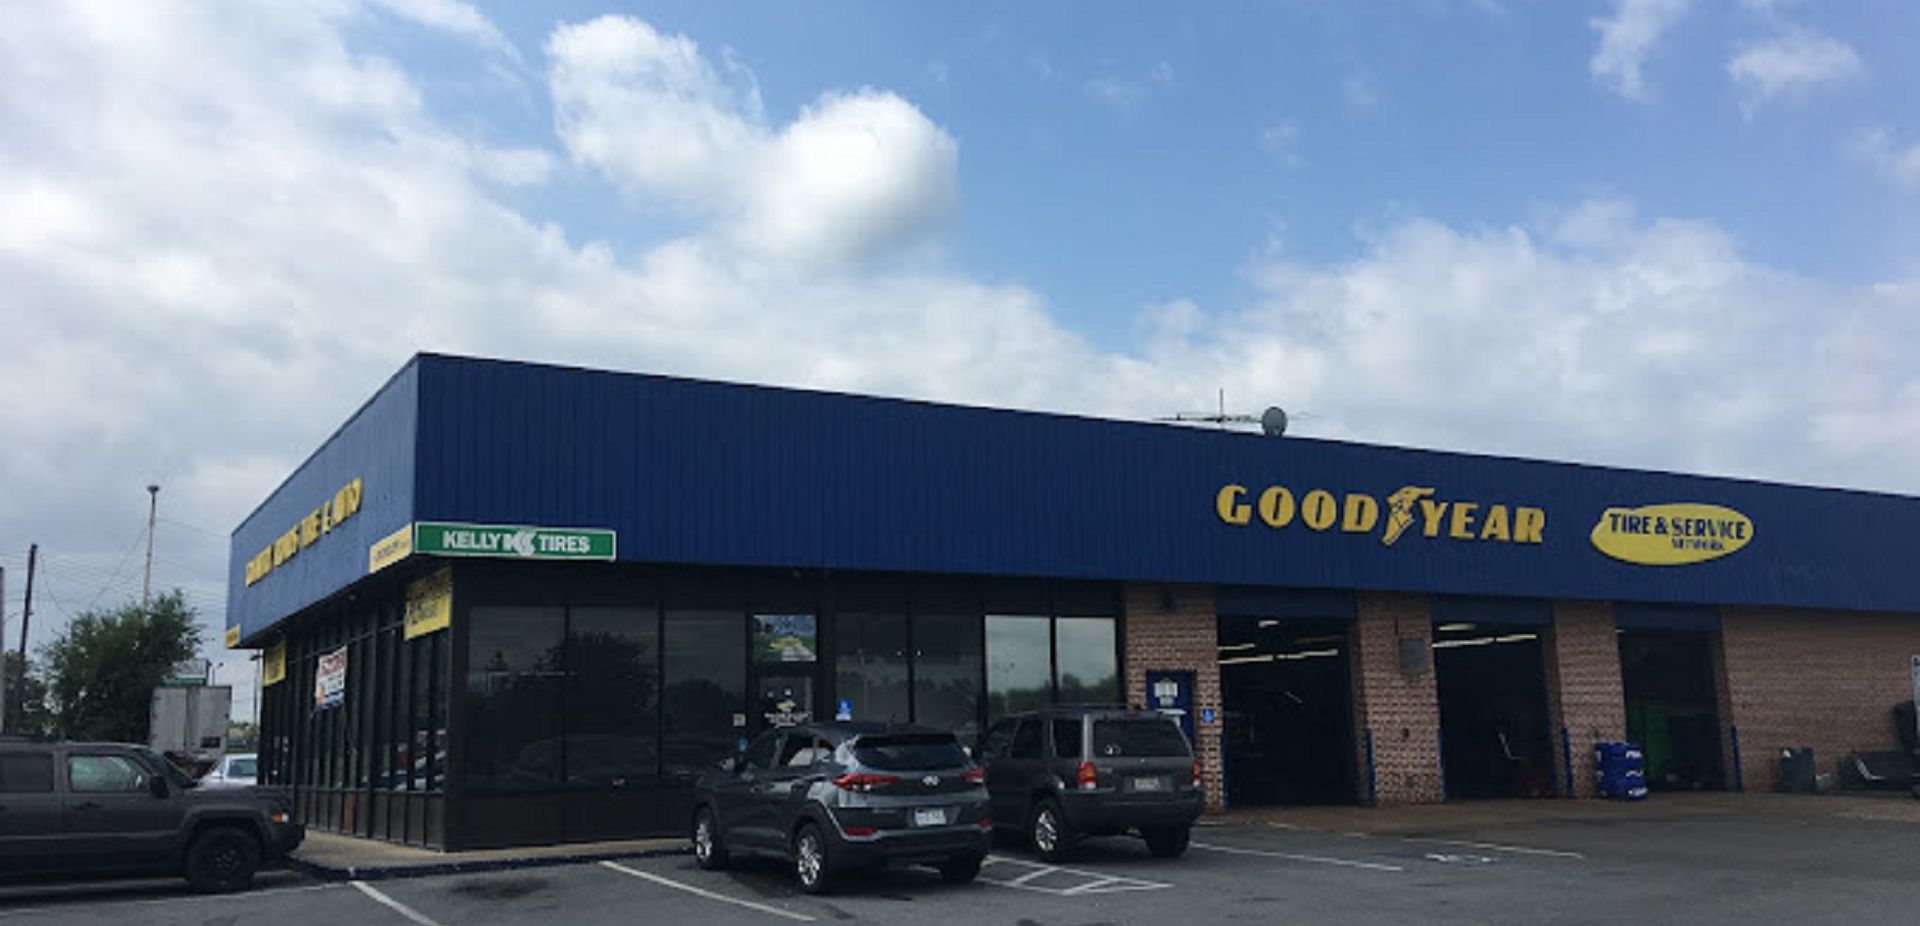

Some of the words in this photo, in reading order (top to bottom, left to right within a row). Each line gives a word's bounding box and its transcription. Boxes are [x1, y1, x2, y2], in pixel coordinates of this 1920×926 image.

[1609, 513, 1652, 534] TIRE
[1654, 516, 1668, 535] &
[1671, 517, 1746, 540] SERVICE
[442, 530, 501, 550] KELLY
[537, 534, 591, 553] TIRES
